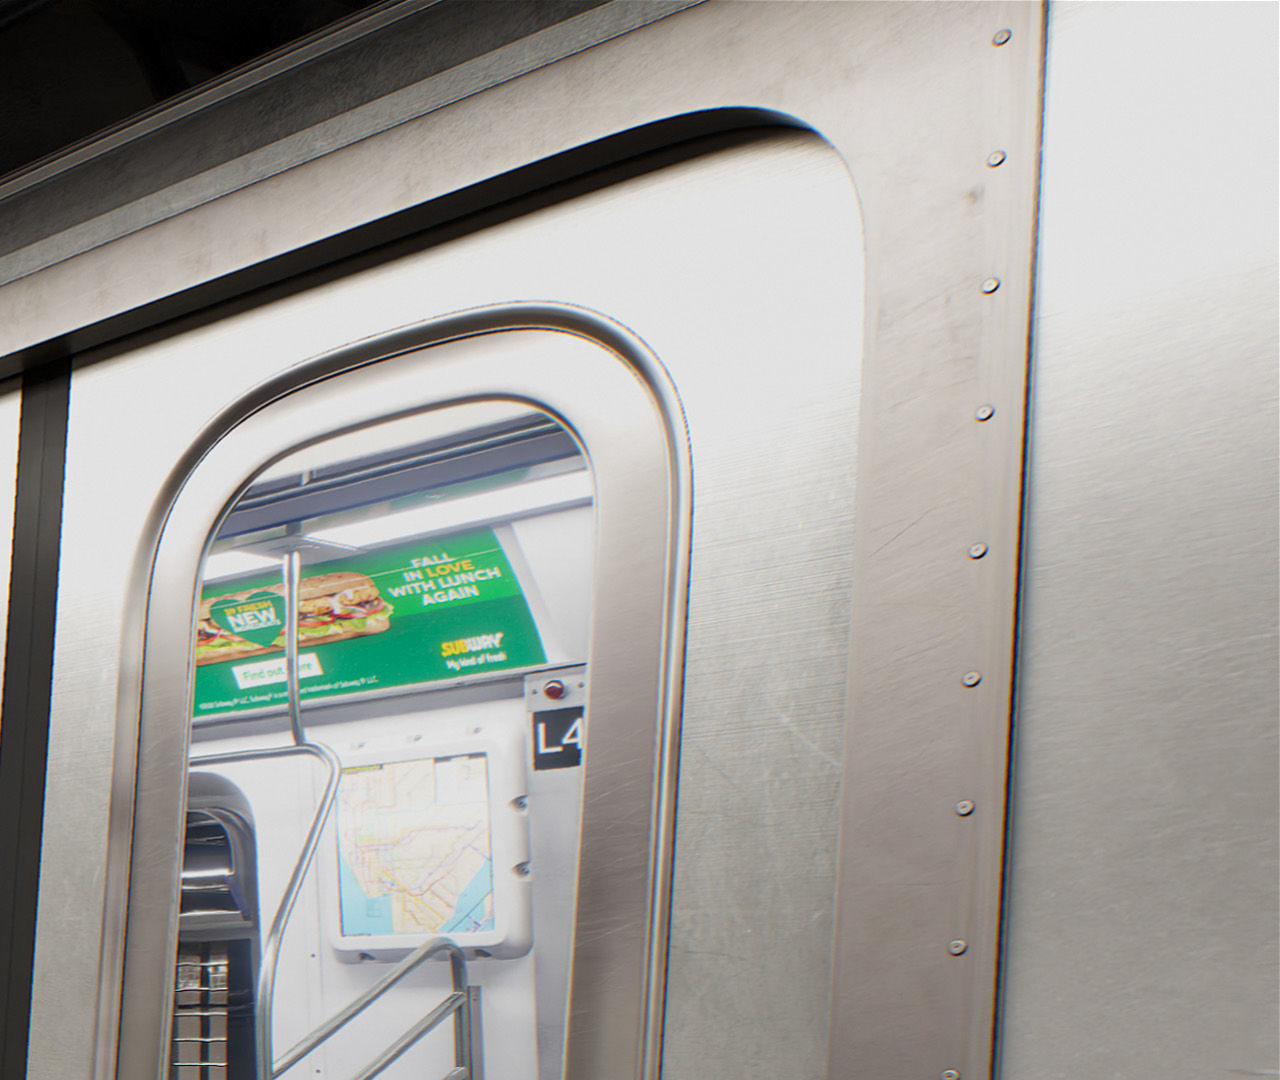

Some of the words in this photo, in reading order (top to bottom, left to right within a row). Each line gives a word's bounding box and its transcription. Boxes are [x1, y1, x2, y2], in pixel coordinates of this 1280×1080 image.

[403, 570, 425, 583] IN
[425, 559, 475, 578] LOVE
[410, 553, 456, 568] FALL
[387, 580, 437, 598] WITH
[438, 566, 502, 589] LUNCH
[422, 585, 480, 607] AGAIN
[227, 607, 276, 629] NEW
[537, 717, 585, 754] L4
